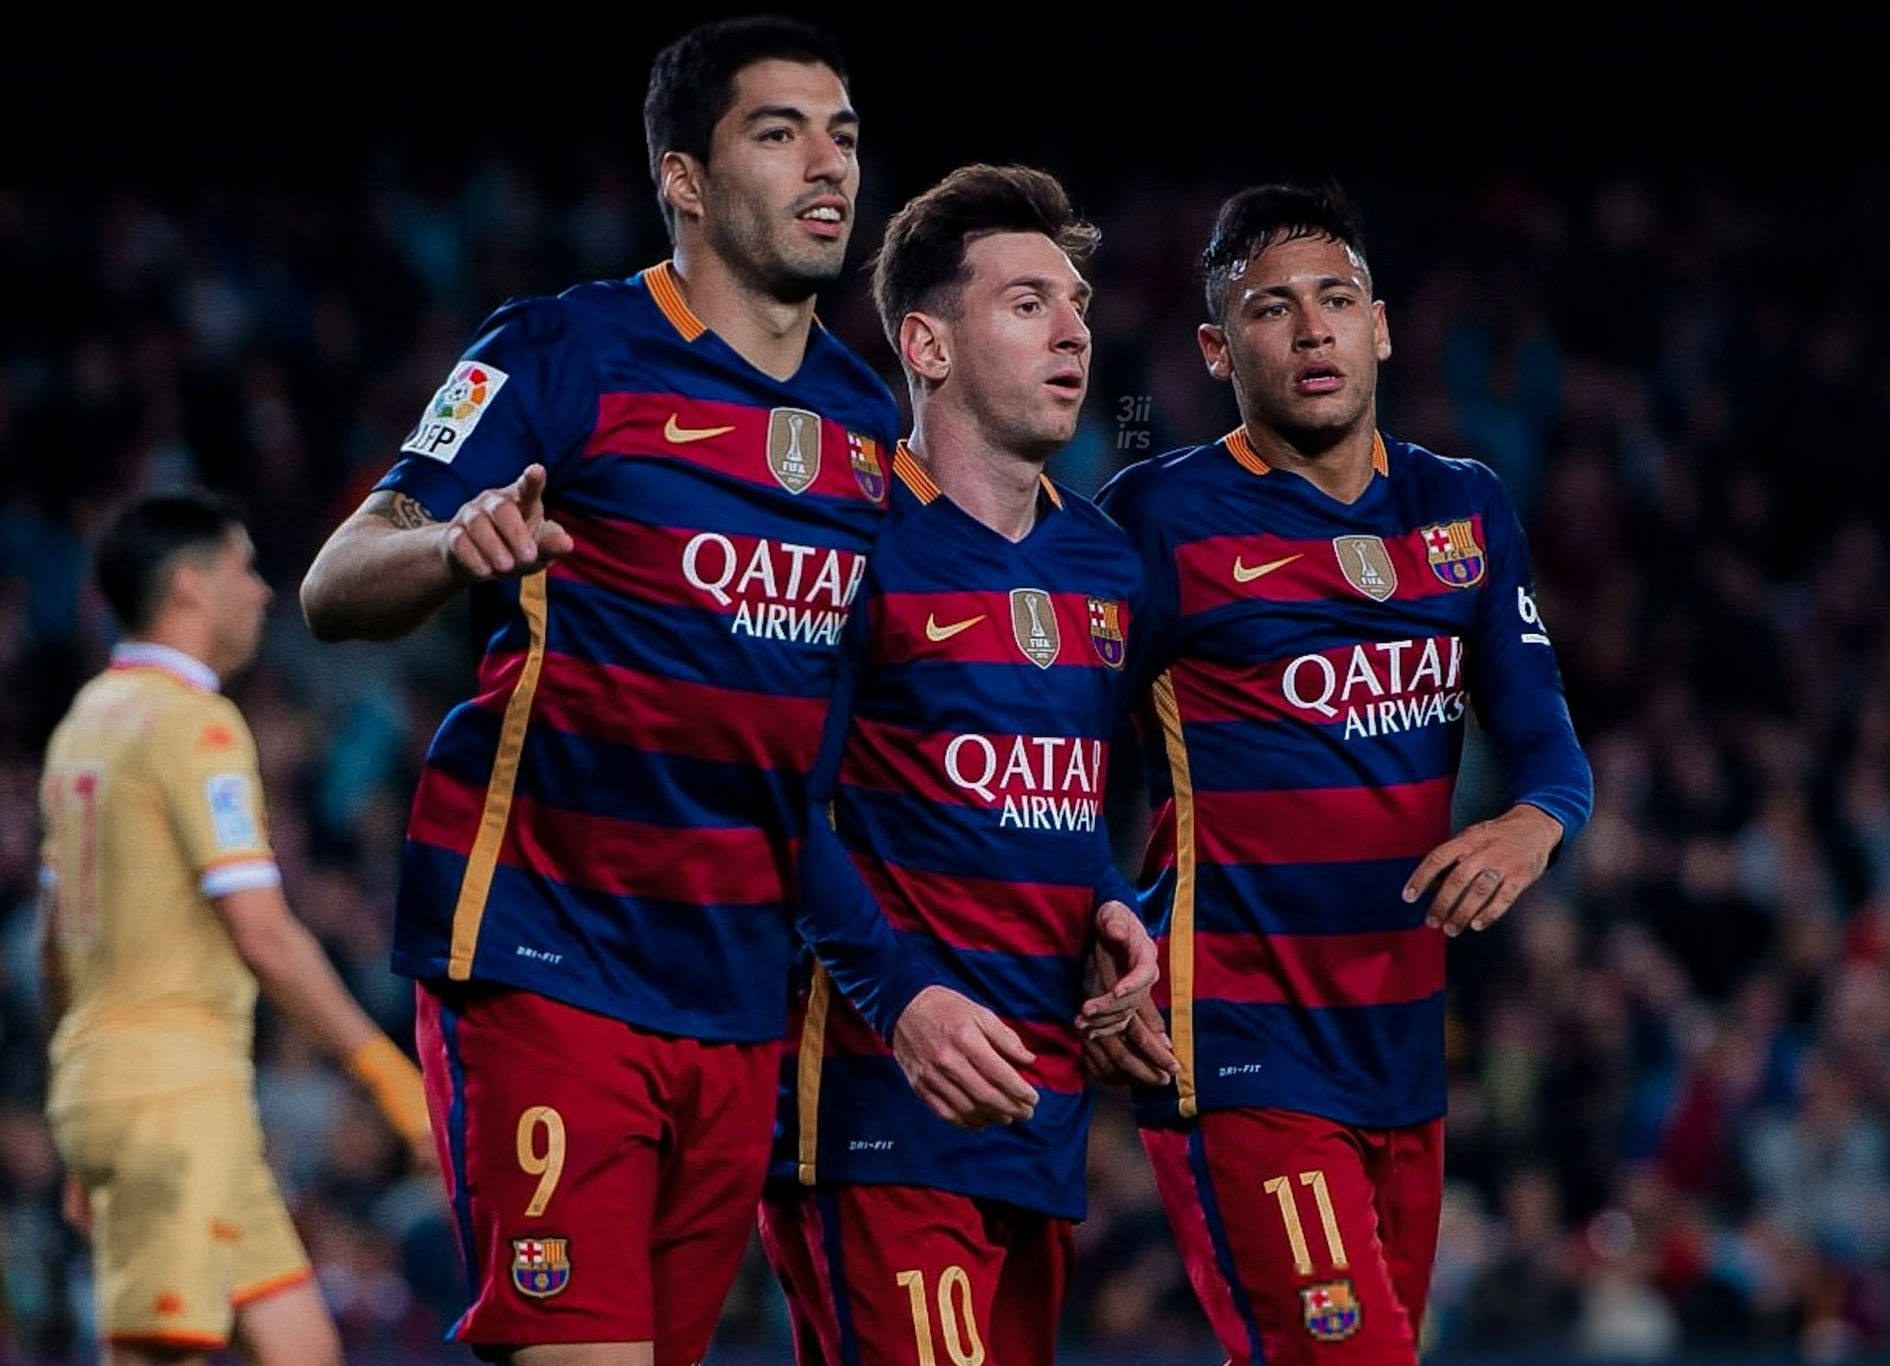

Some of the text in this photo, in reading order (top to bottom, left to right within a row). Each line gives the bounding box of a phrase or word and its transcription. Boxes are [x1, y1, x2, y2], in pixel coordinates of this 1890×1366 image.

[731, 599, 848, 647] AIRWAY
[999, 793, 1099, 833] AIRWAY
[516, 1105, 567, 1217] 9
[1263, 1170, 1348, 1275] 11
